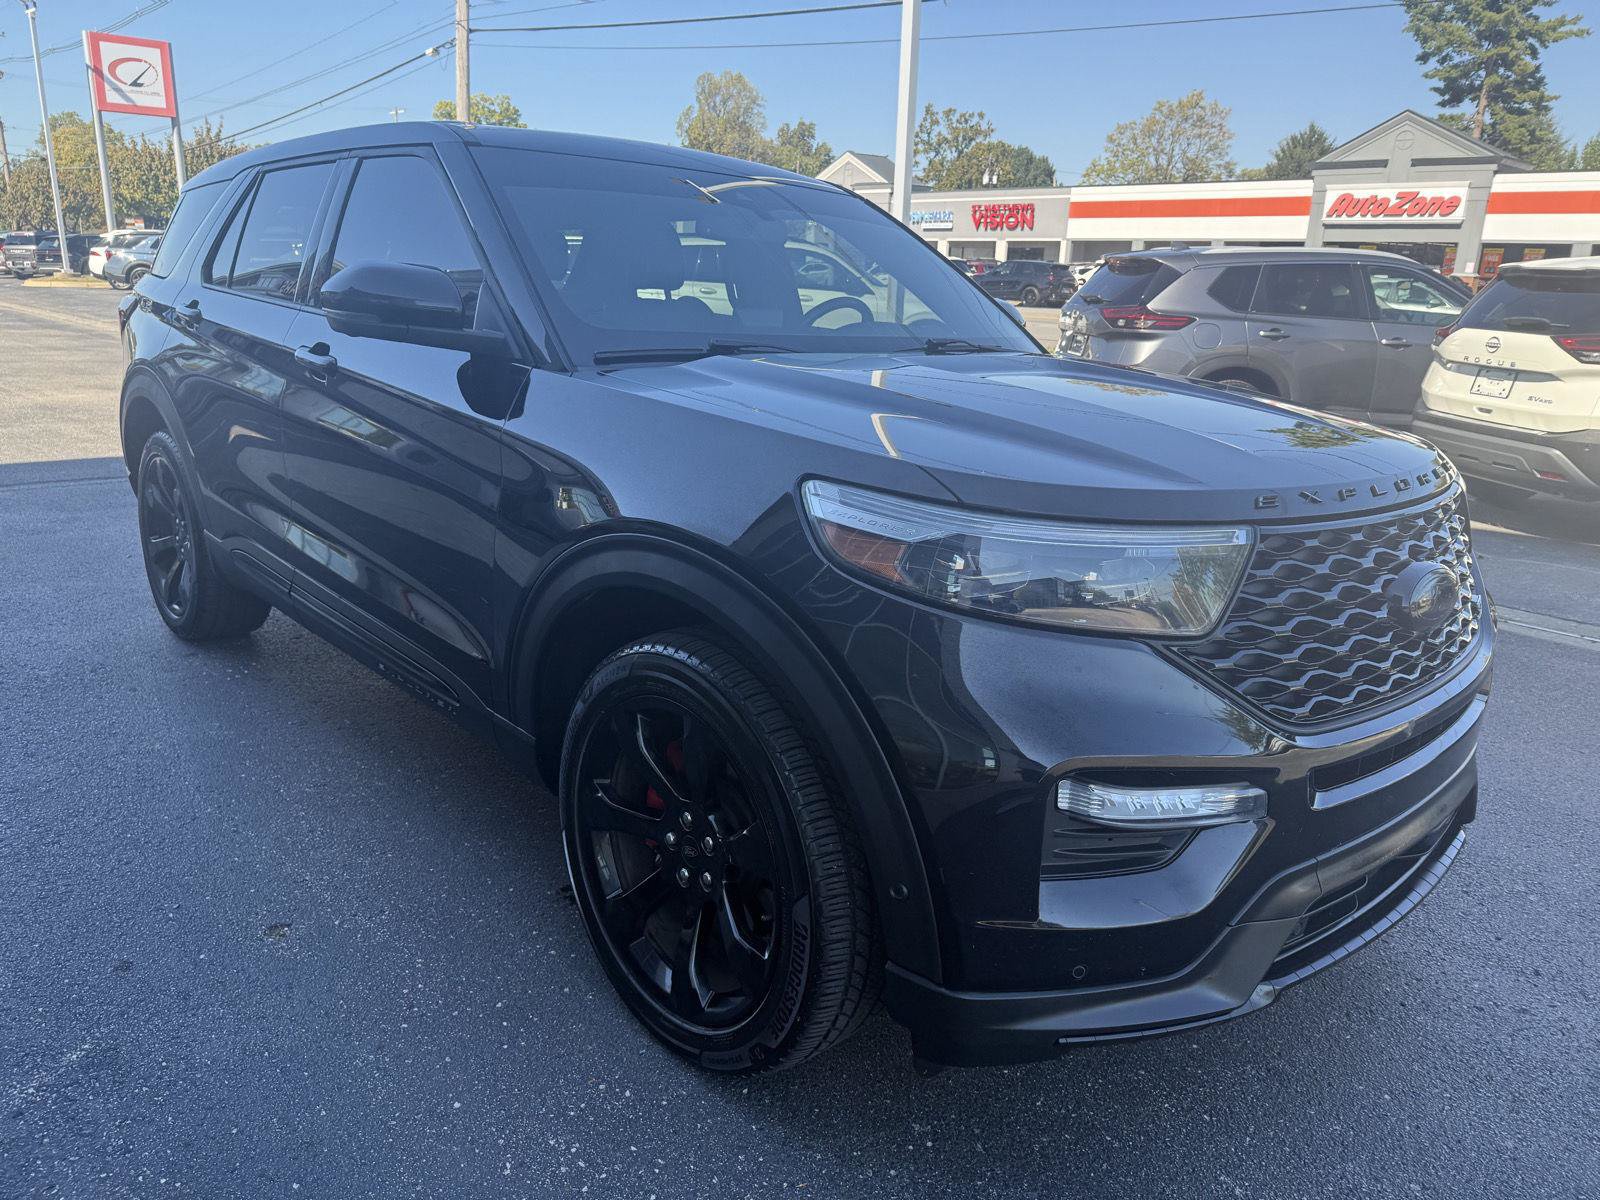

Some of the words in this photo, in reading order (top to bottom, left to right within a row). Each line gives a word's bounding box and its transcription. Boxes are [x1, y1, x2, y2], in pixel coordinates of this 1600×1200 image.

[1326, 191, 1462, 217] AutoZone
[972, 212, 1035, 232] VISION
[1464, 355, 1517, 368] ROGUE
